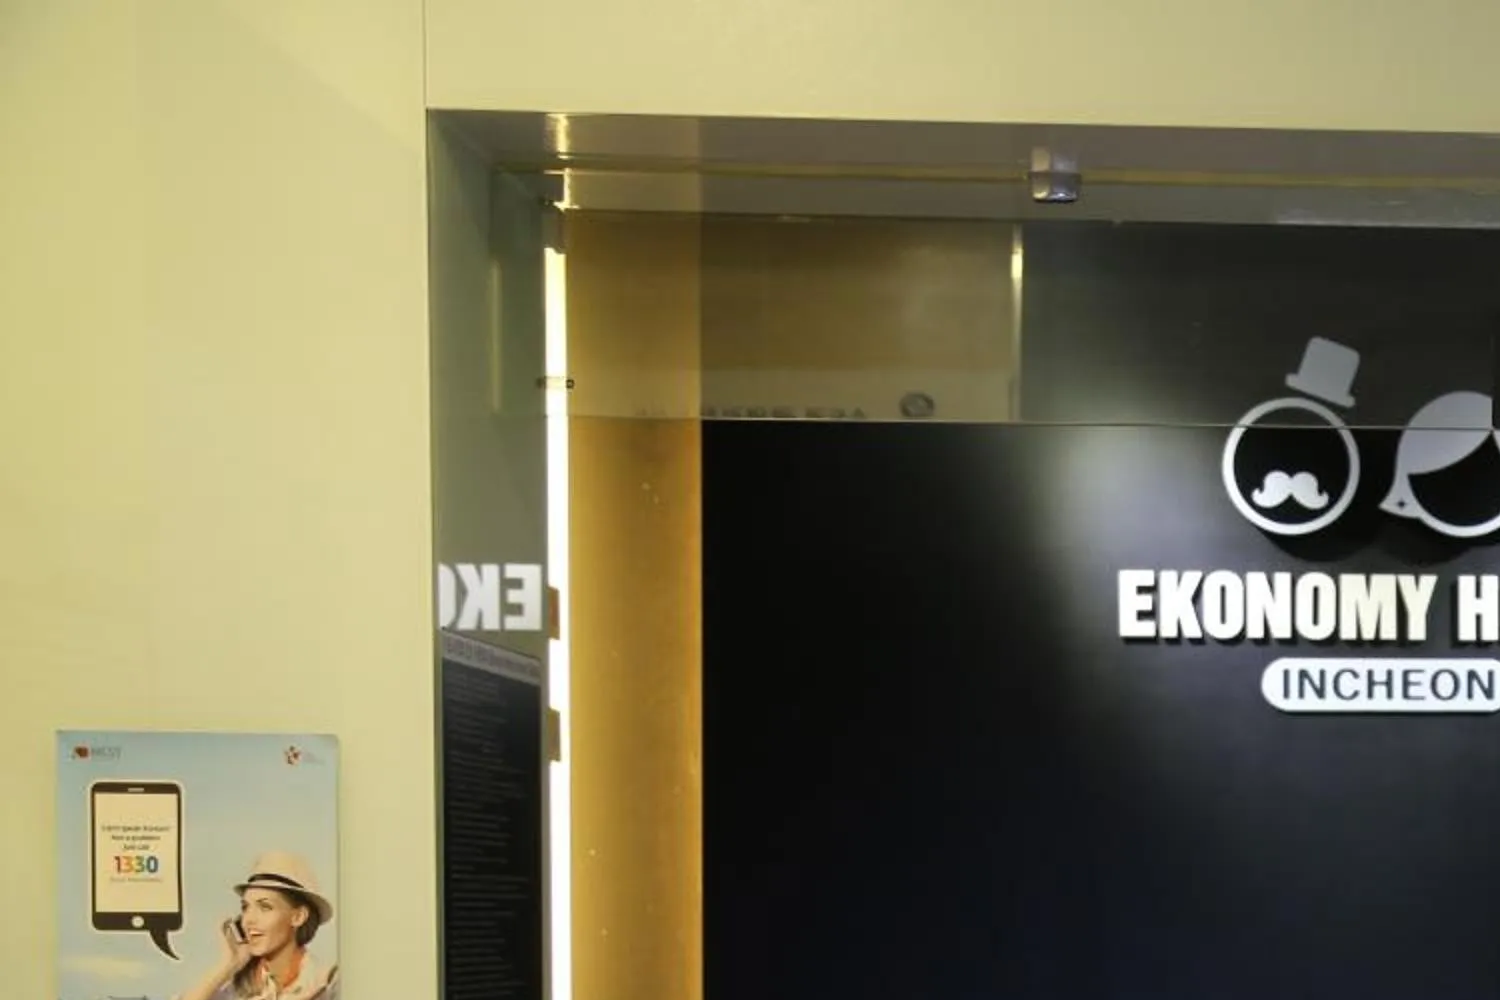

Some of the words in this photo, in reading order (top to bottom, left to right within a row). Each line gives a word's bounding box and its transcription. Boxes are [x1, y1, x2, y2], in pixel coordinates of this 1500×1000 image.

[1117, 569, 1437, 641] EKONOMY
[1281, 668, 1496, 701] INCHEON
[113, 855, 159, 873] 1330
